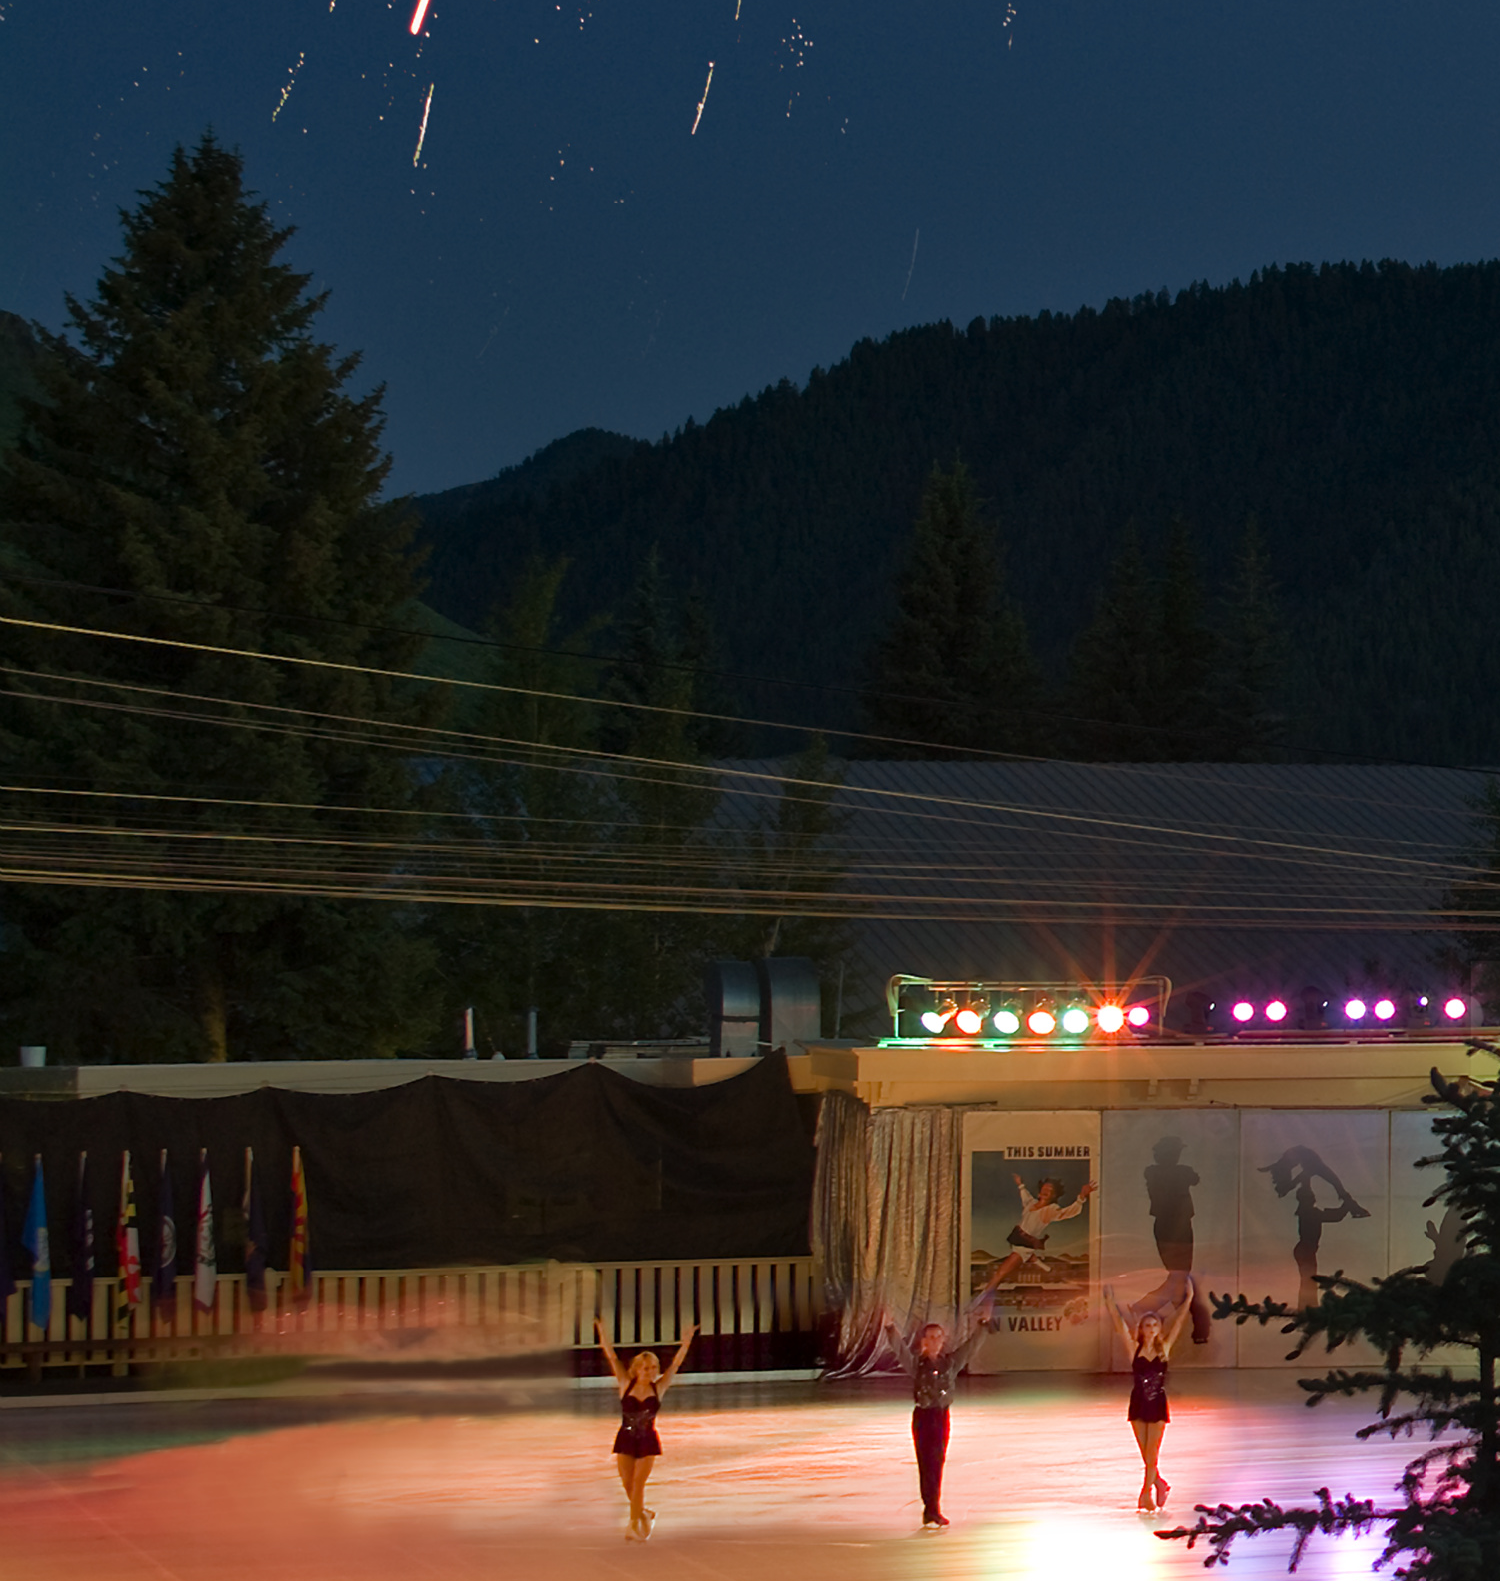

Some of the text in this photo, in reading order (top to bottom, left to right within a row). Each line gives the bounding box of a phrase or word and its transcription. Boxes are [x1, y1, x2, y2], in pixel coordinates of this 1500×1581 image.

[1006, 1145, 1090, 1158] THIS SUMMER
[1008, 1316, 1062, 1332] VALLEY
